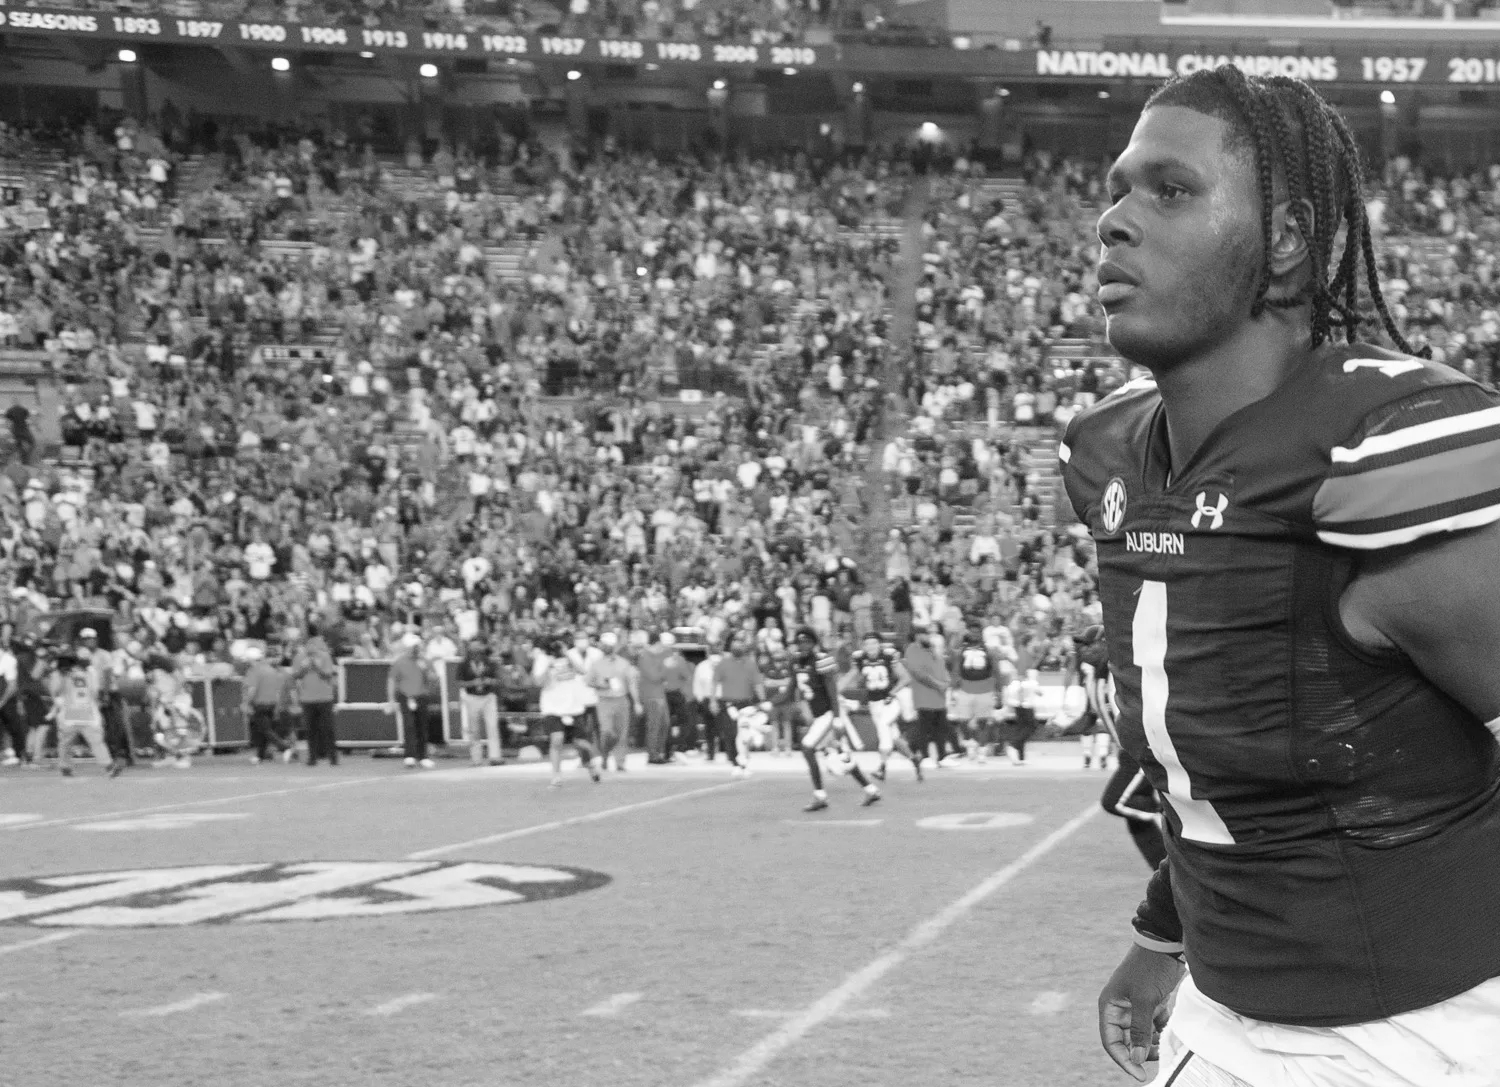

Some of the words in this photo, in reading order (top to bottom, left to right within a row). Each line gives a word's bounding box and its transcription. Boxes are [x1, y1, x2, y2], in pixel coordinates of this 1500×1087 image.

[9, 12, 97, 31] SEASONS
[113, 17, 160, 35] 1893
[177, 20, 223, 38] 1897
[239, 24, 286, 42] 1900
[362, 30, 408, 48] 1913
[423, 33, 468, 50] 1914
[1036, 51, 1171, 77] NATIONAL
[1177, 54, 1338, 81] CHMPIONS
[1362, 57, 1426, 82] 1957
[1103, 482, 1125, 531] SEC
[1126, 532, 1185, 555] AUBURN
[1132, 580, 1236, 845] 1
